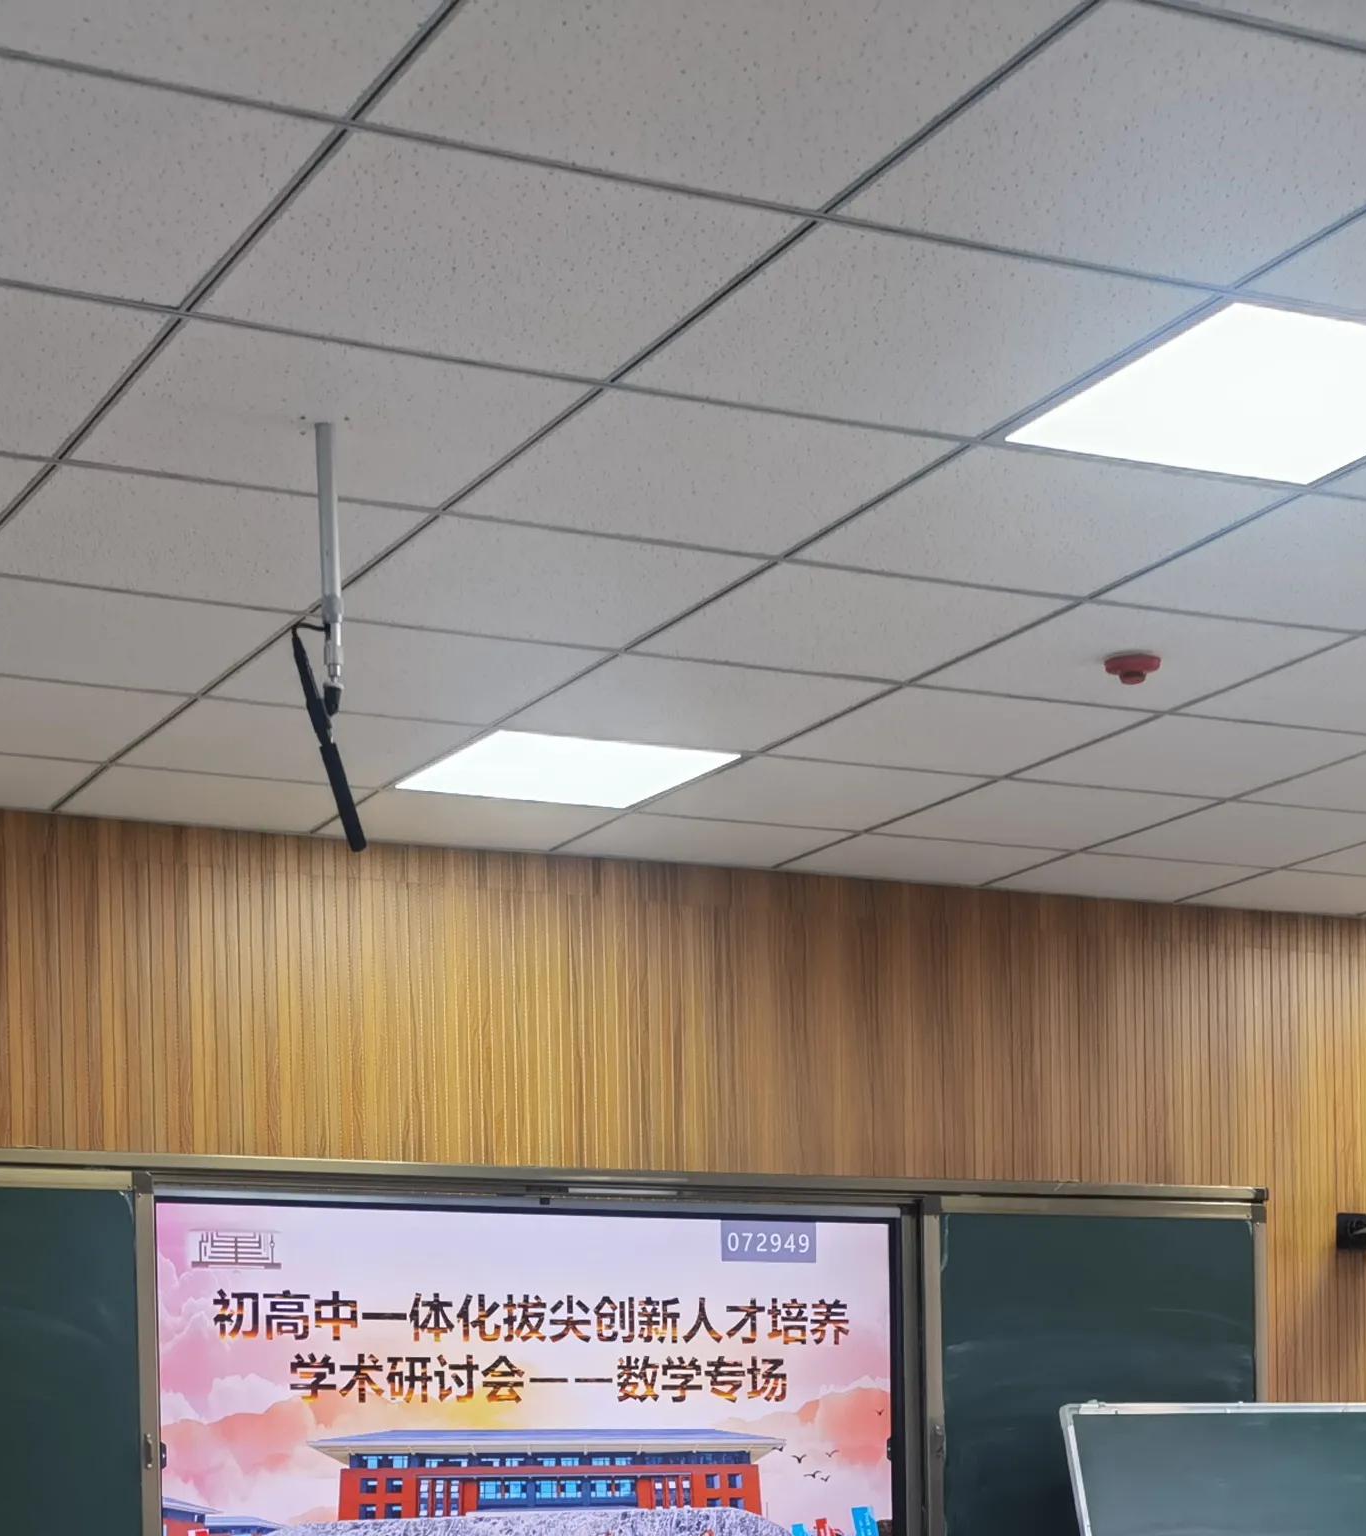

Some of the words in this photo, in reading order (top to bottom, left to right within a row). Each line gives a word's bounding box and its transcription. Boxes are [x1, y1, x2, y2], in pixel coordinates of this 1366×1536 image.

[727, 1233, 810, 1253] 072949
[212, 1289, 850, 1345] 初高中一体化拔尖创新人才培养
